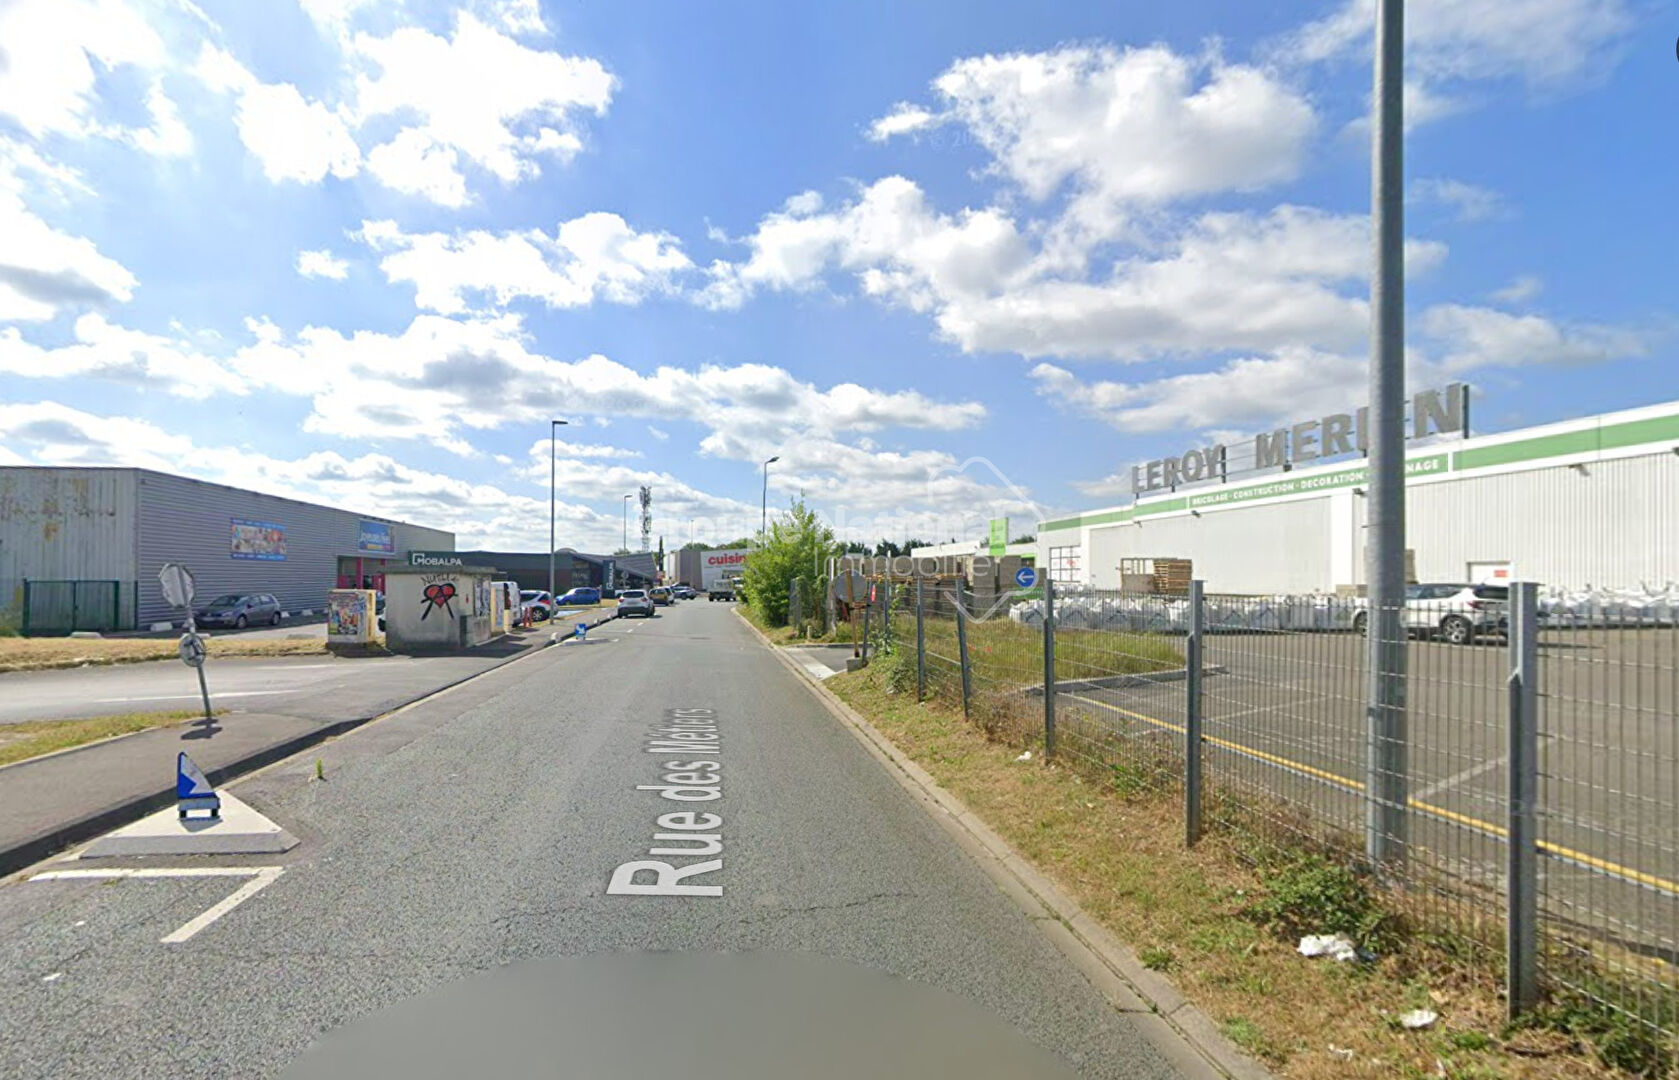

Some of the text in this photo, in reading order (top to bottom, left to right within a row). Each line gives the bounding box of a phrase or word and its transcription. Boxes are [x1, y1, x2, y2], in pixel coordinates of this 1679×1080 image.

[1131, 382, 1462, 494] LEROY MERN
[1192, 492, 1229, 506] BRICOLAGE
[1233, 481, 1294, 500] CONSTRUCTION
[412, 552, 463, 567] MOBALPA
